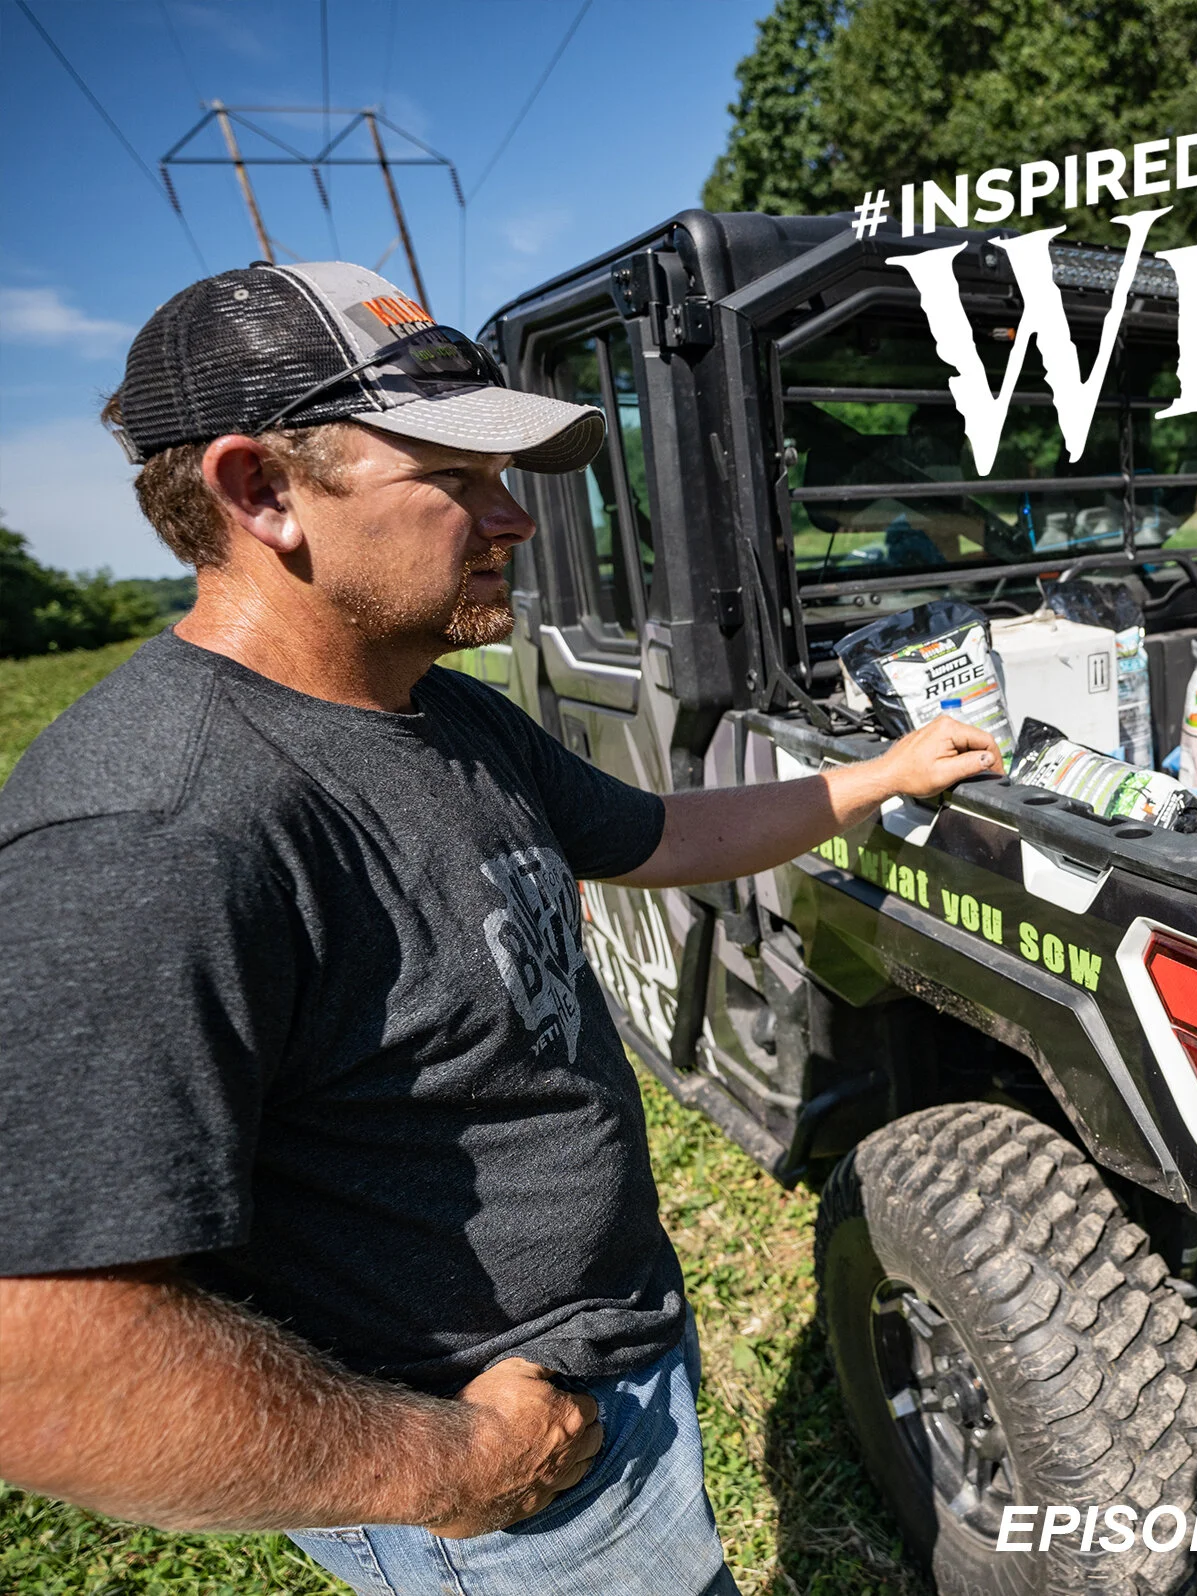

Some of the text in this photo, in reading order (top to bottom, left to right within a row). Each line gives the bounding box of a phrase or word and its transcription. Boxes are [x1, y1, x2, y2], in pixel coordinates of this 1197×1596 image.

[925, 664, 986, 700] RAGE
[858, 845, 931, 910] what
[941, 887, 1004, 946] you
[1018, 920, 1103, 993] sow
[530, 1022, 562, 1058] YETI
